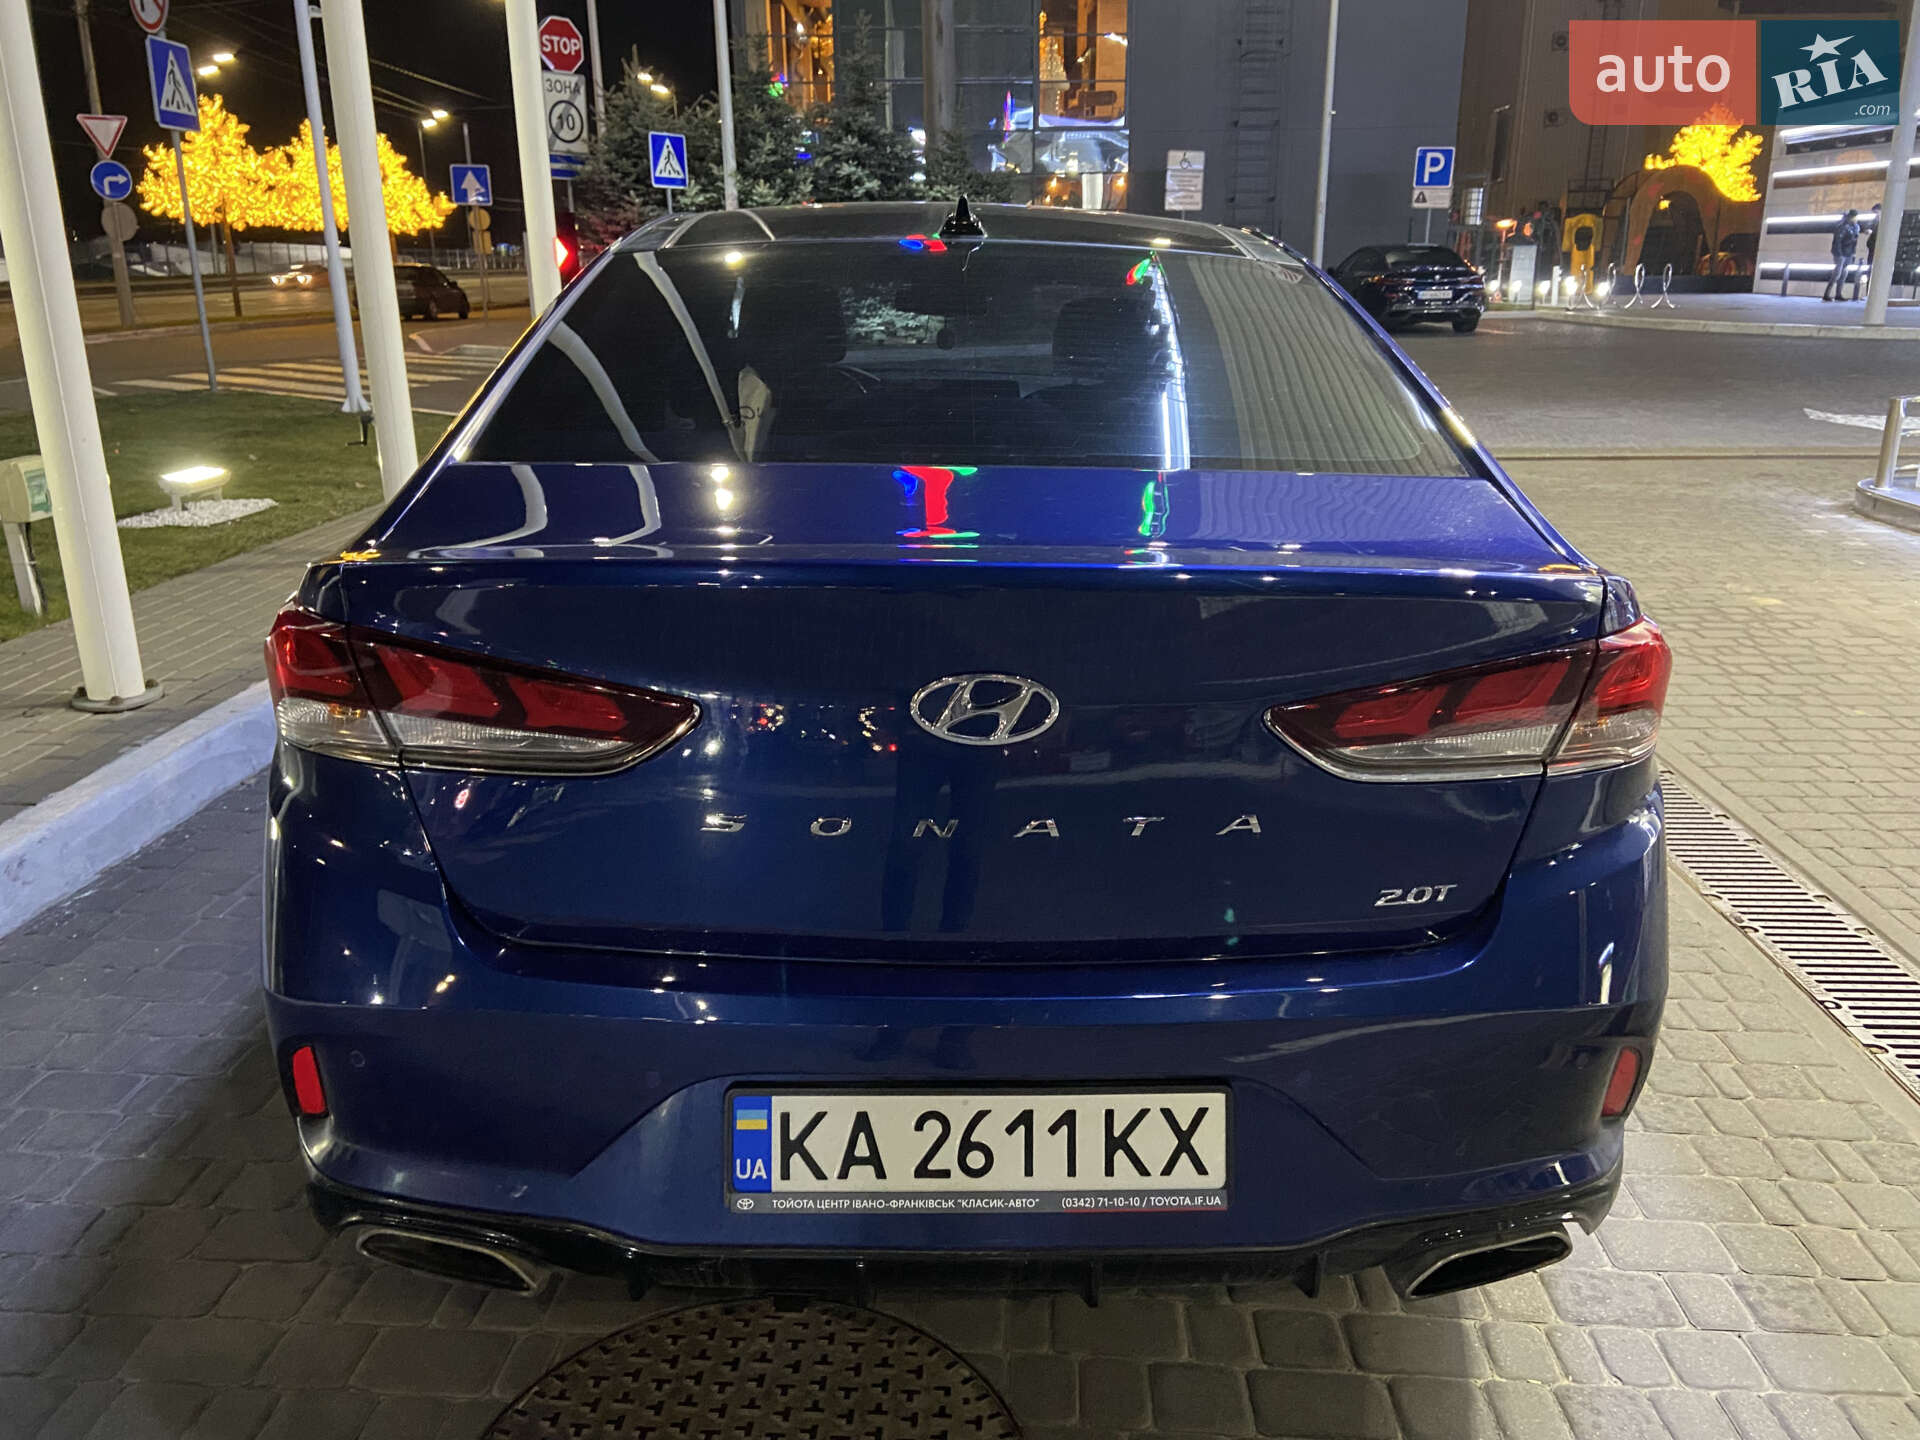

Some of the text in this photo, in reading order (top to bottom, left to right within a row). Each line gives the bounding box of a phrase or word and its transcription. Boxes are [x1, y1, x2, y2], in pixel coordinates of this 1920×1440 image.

[542, 35, 580, 56] STOP
[545, 79, 581, 95] ЗОНА
[556, 113, 576, 131] 10
[1424, 152, 1445, 183] P
[700, 813, 1262, 837] SONATA
[779, 1107, 1209, 1181] KA 2611 KX
[736, 1157, 767, 1179] UA
[772, 1198, 815, 1209] ТОЙОТА
[817, 1199, 850, 1211] ЦЕНТР
[852, 1198, 955, 1210] ІВАНО-ФРАНКІВСЬК
[1061, 1196, 1095, 1208] (0342)
[1097, 1197, 1140, 1208] 71-10-10
[1150, 1195, 1222, 1207] TOYOTA.IF.UA
